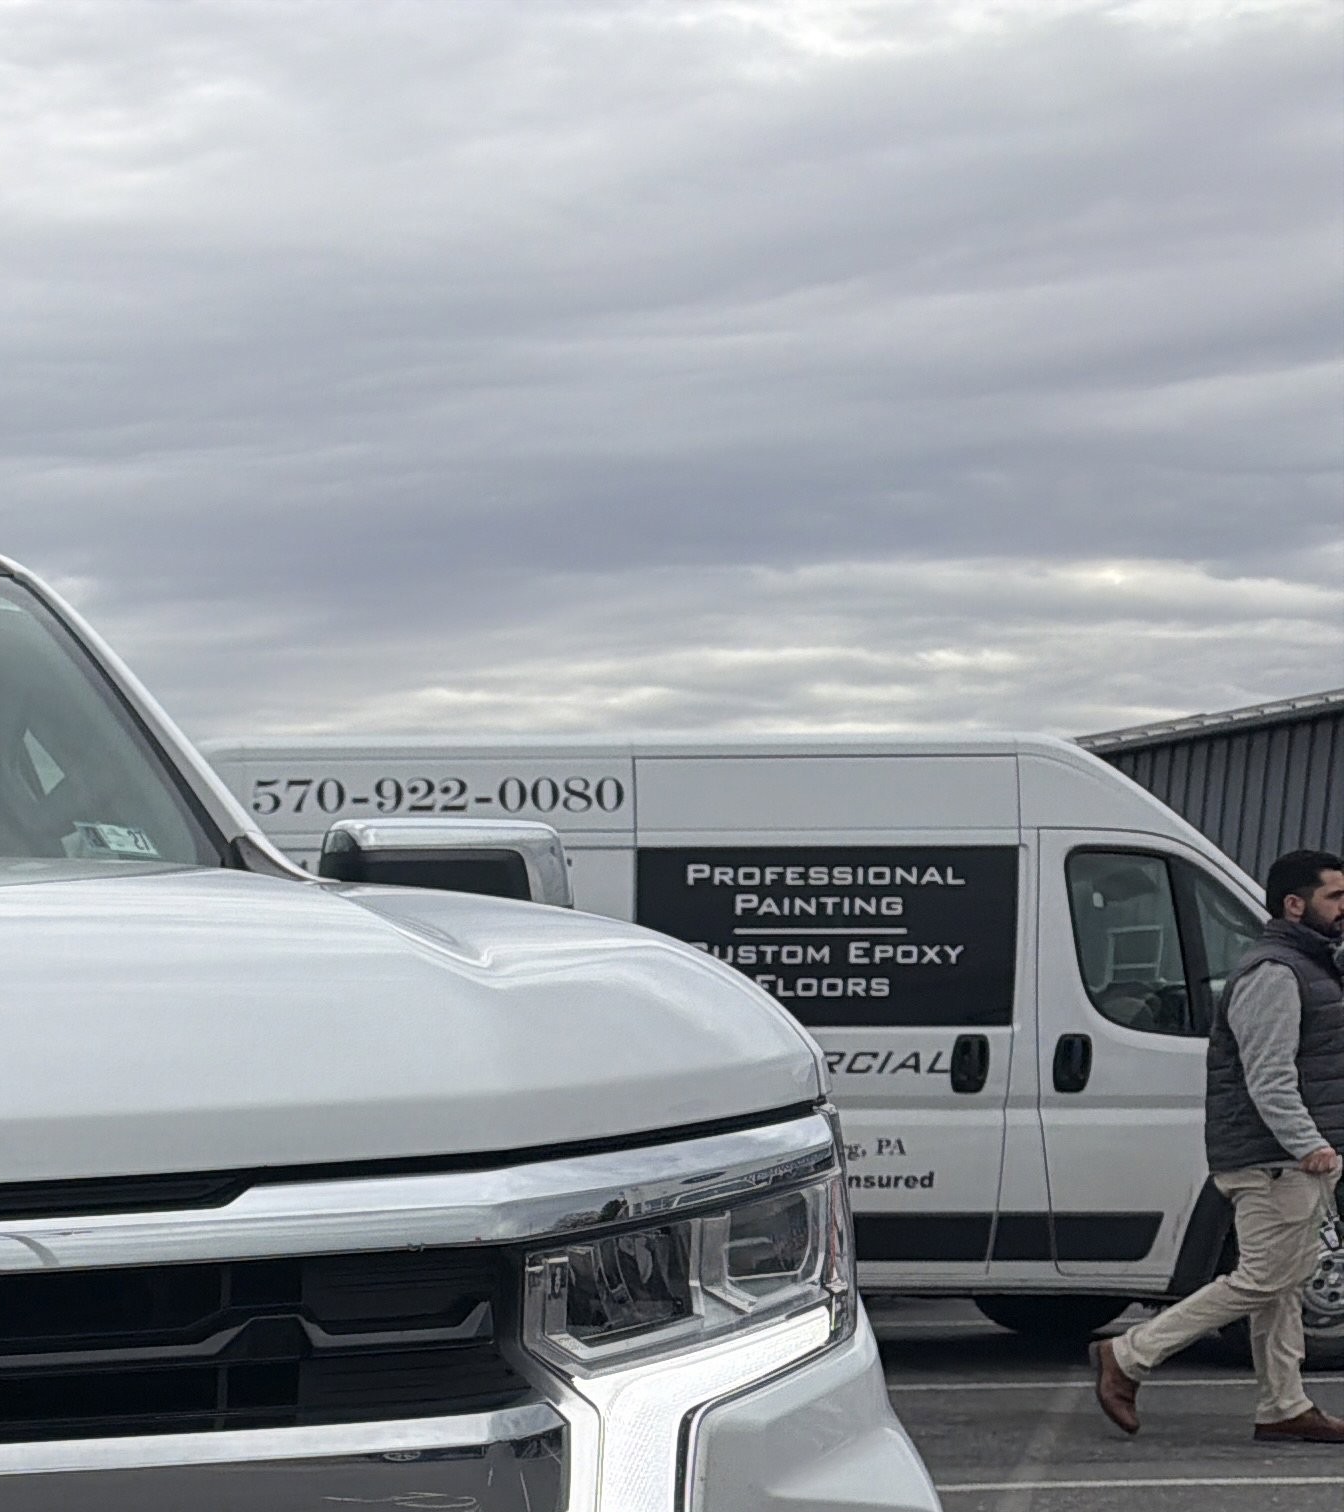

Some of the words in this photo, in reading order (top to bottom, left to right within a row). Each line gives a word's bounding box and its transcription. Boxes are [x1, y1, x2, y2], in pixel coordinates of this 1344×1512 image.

[252, 776, 625, 814] 570-922-0080
[686, 863, 966, 886] PROFESSIONAL
[734, 894, 904, 916] PAINTING
[848, 941, 964, 965] EPOXY
[823, 1051, 950, 1074] RCIAL
[876, 1137, 907, 1156] PA
[847, 1170, 934, 1189] nsured
